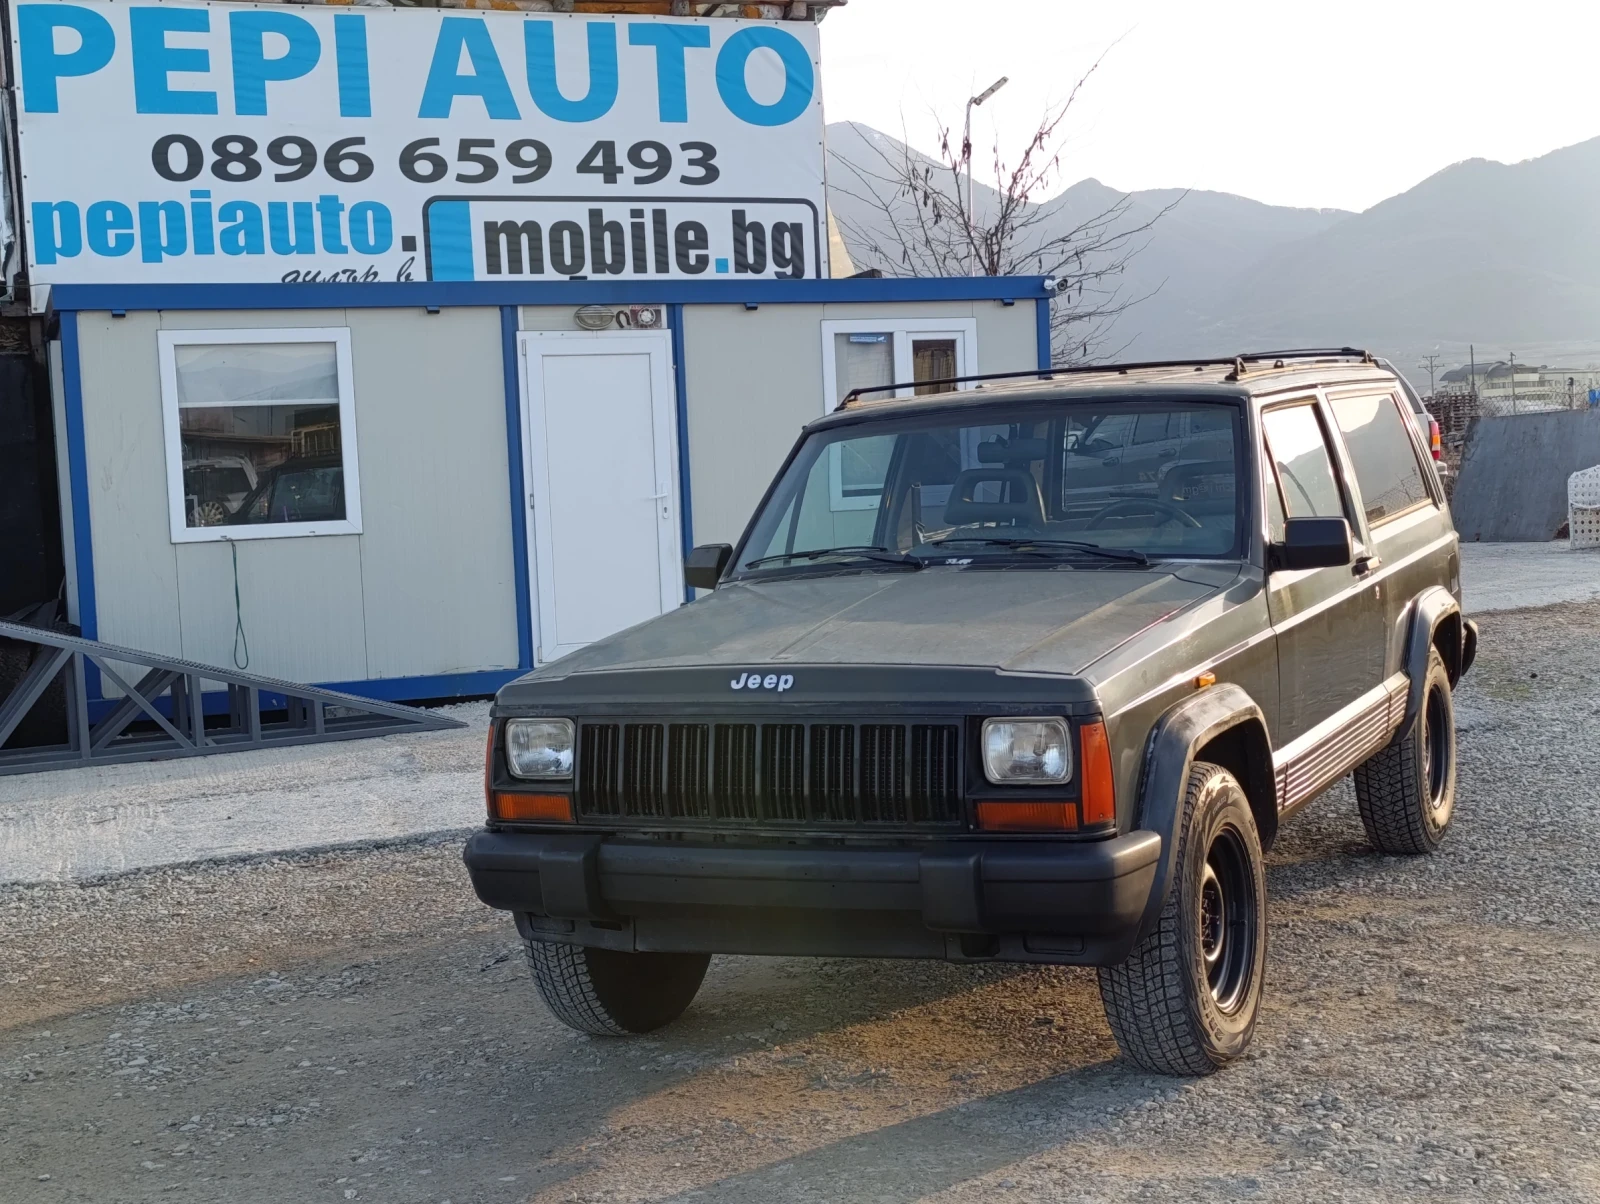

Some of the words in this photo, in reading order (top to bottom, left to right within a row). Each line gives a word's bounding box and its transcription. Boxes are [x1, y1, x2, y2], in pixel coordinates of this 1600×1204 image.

[17, 4, 372, 117] PEPI
[417, 16, 814, 127] AUTO
[151, 133, 375, 183] 0896
[399, 137, 553, 184] 659
[576, 140, 720, 185] 493
[484, 208, 806, 280] mobile.bg
[730, 672, 794, 692] Jeep
